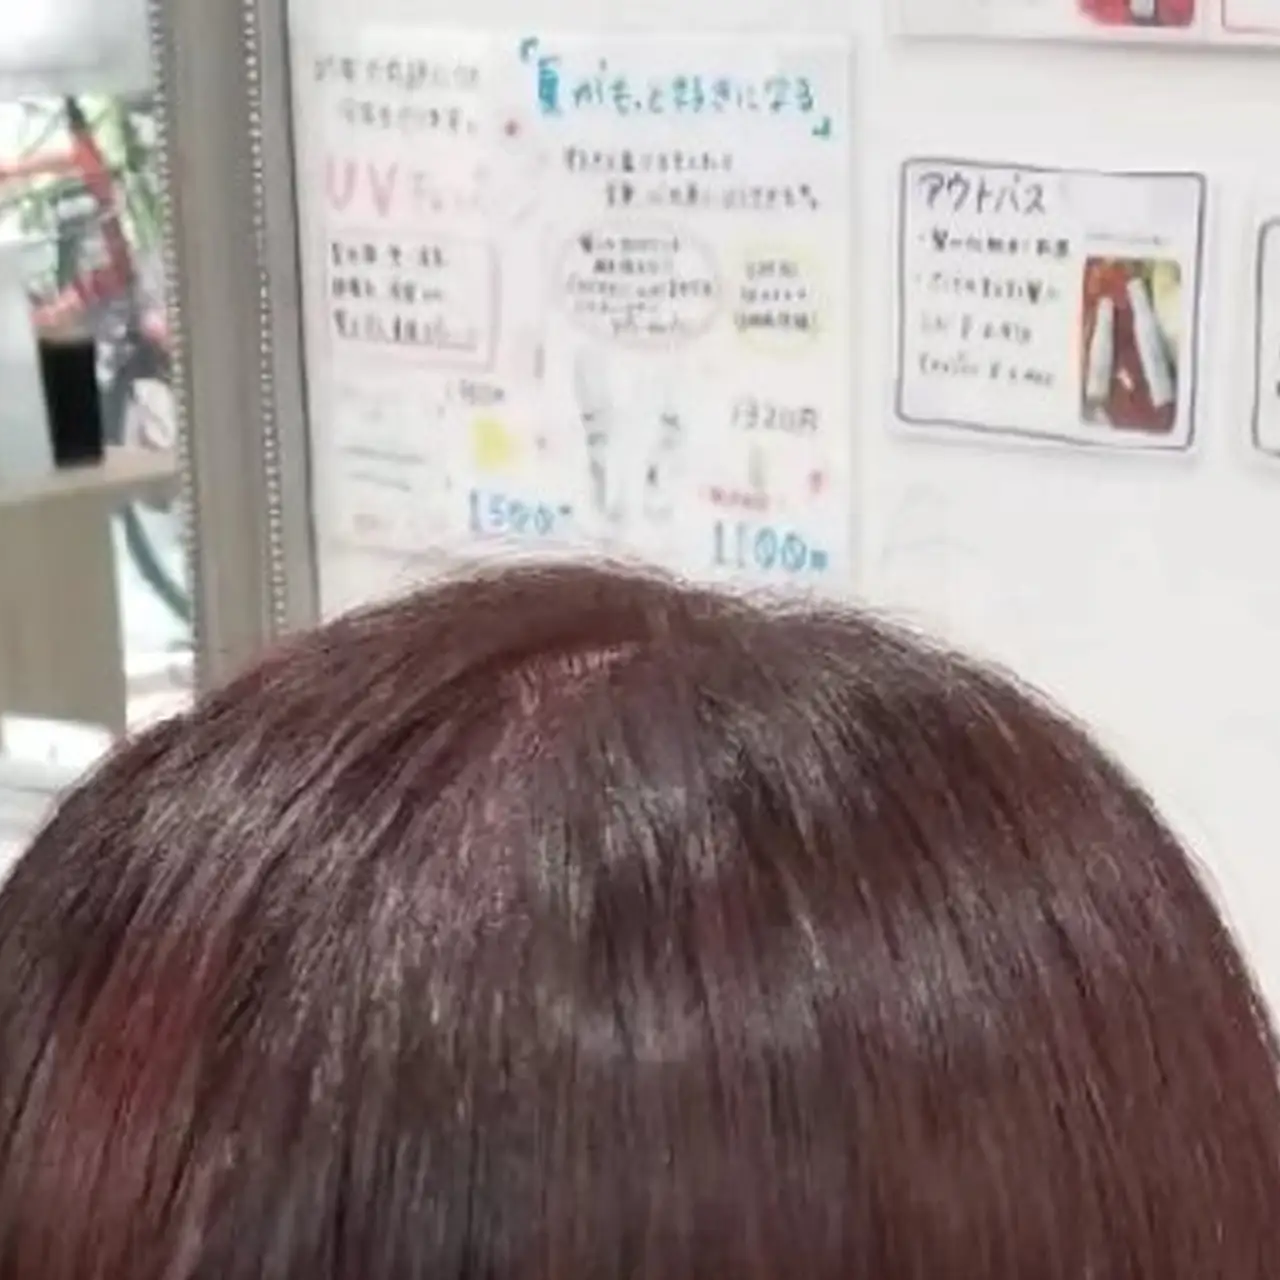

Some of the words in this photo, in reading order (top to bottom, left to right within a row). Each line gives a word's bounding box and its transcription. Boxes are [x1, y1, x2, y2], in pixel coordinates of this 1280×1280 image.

[919, 171, 1047, 215] アウトバス
